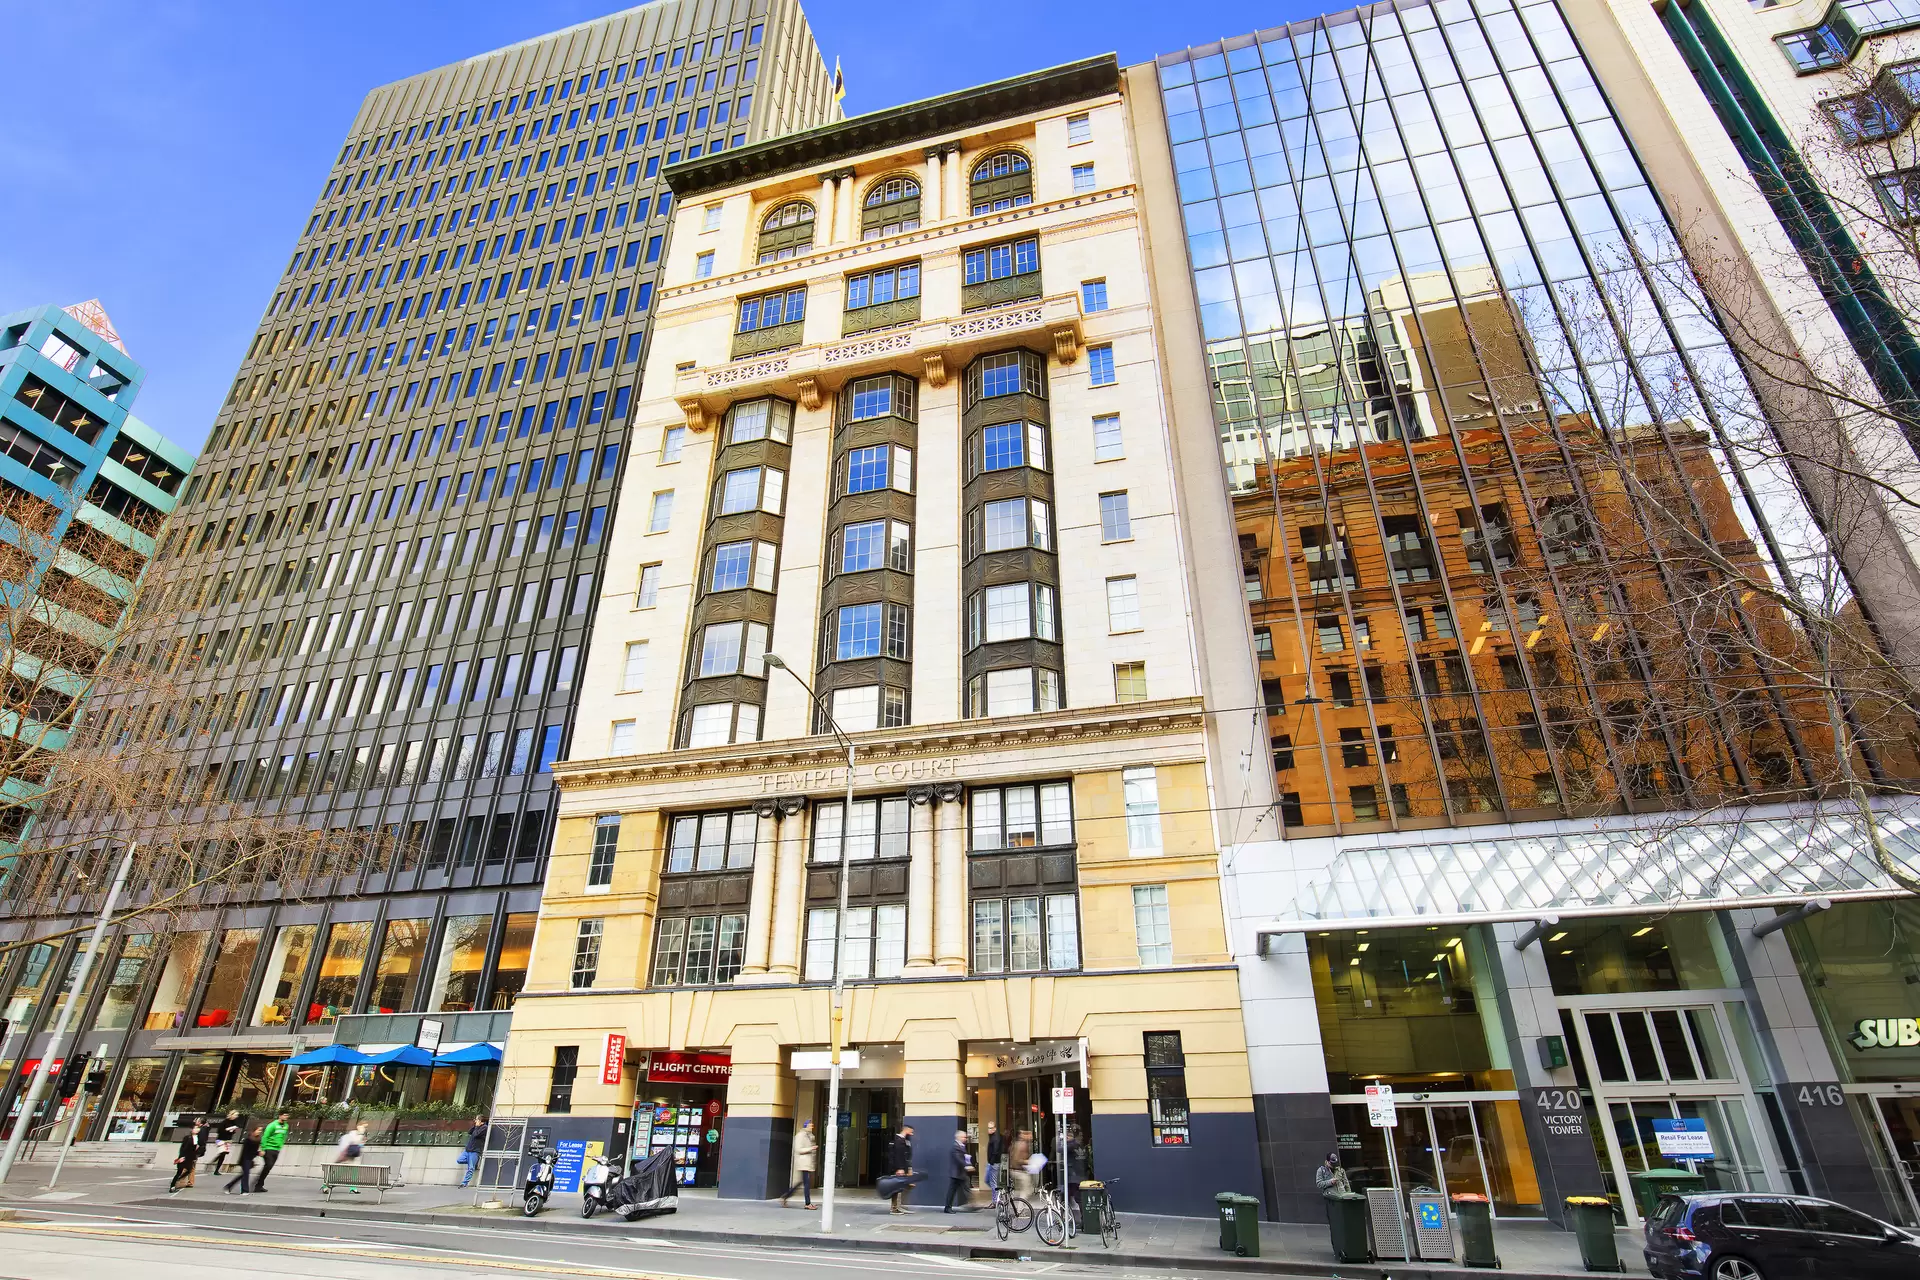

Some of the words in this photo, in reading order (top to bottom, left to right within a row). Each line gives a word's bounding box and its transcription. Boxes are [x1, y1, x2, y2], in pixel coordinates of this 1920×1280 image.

[872, 757, 961, 782] COURT
[1853, 1018, 1920, 1048] SUB
[607, 1038, 617, 1080] FLIGHT
[612, 1038, 622, 1082] CENTRE
[653, 1062, 692, 1073] FLIGHT
[693, 1064, 732, 1075] CENTRE
[919, 1079, 941, 1096] 422
[1798, 1084, 1844, 1106] 416
[1537, 1089, 1581, 1110] 420
[1370, 1112, 1382, 1121] 2P
[1543, 1115, 1583, 1125] VICTORY
[1548, 1125, 1584, 1135] TOWER
[559, 1141, 568, 1149] For
[568, 1141, 583, 1149] Lease
[1164, 1136, 1184, 1145] OPEN
